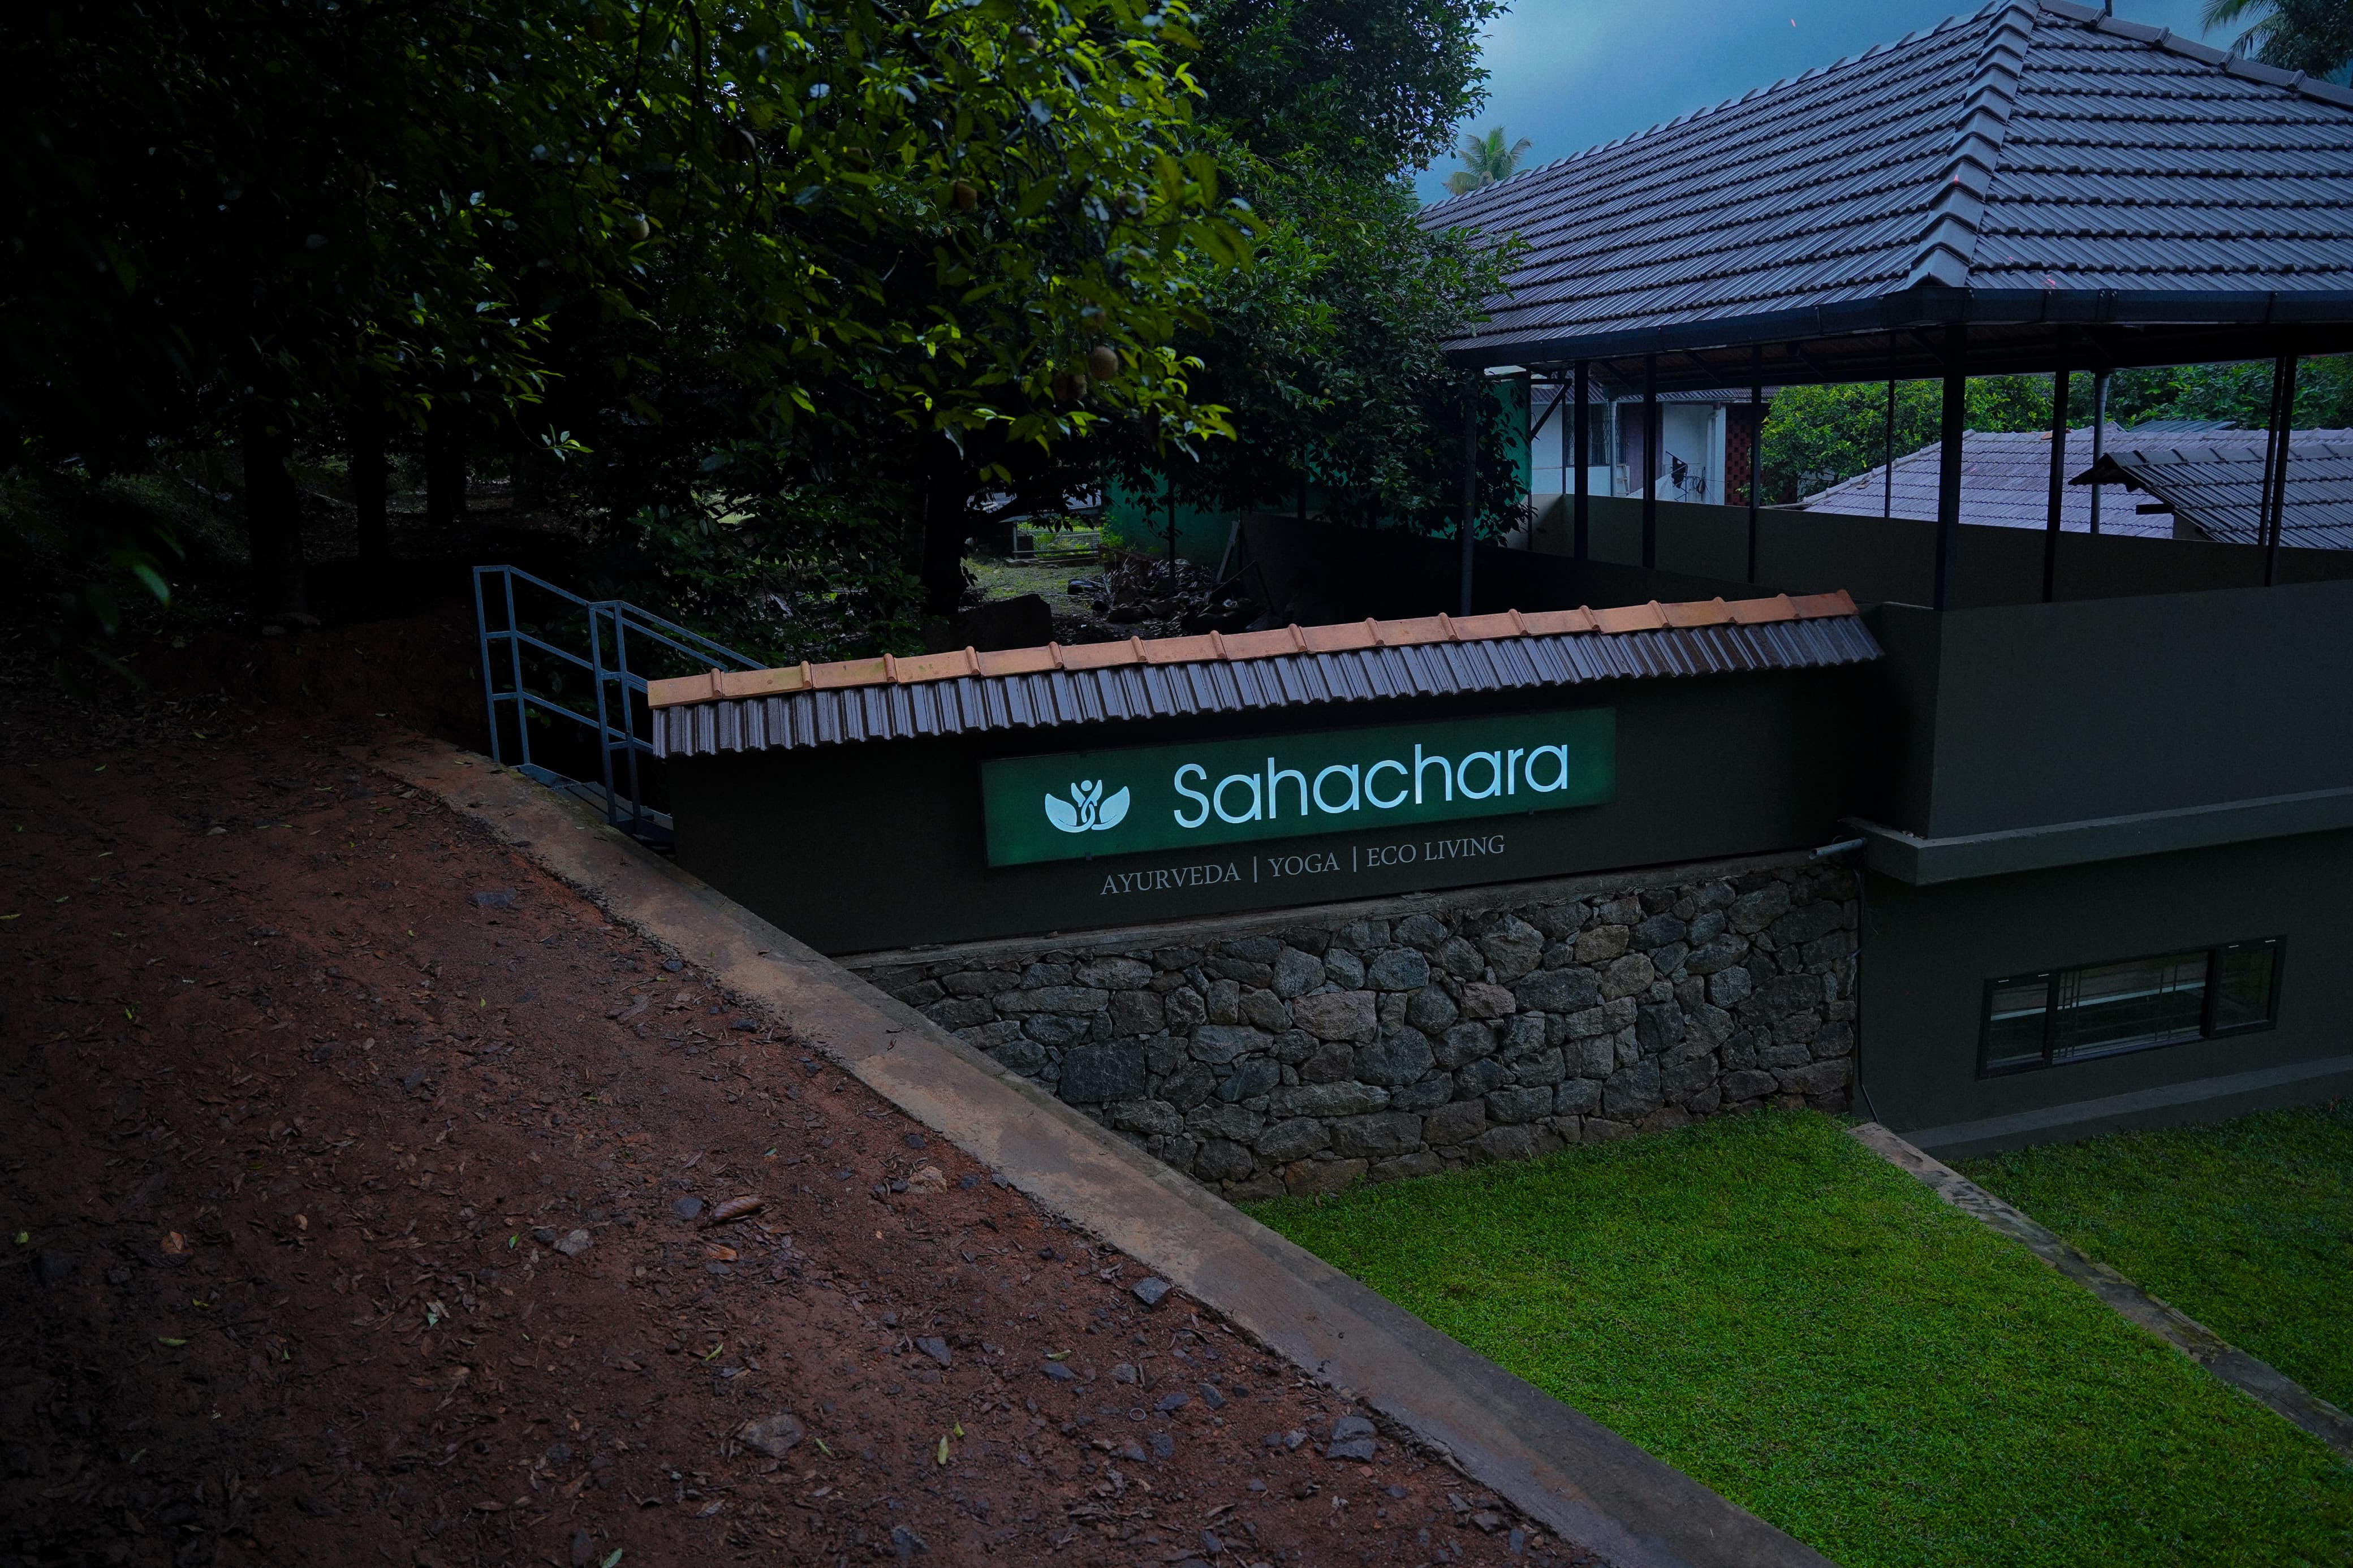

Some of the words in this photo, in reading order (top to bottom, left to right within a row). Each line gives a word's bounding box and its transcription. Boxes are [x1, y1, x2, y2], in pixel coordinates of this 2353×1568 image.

[1174, 744, 1567, 828] Sahachara
[1100, 862, 1241, 895] AYURVEDA
[1267, 852, 1341, 877] YOGA
[1367, 844, 1416, 867] ECO
[1424, 835, 1505, 861] LIVING
